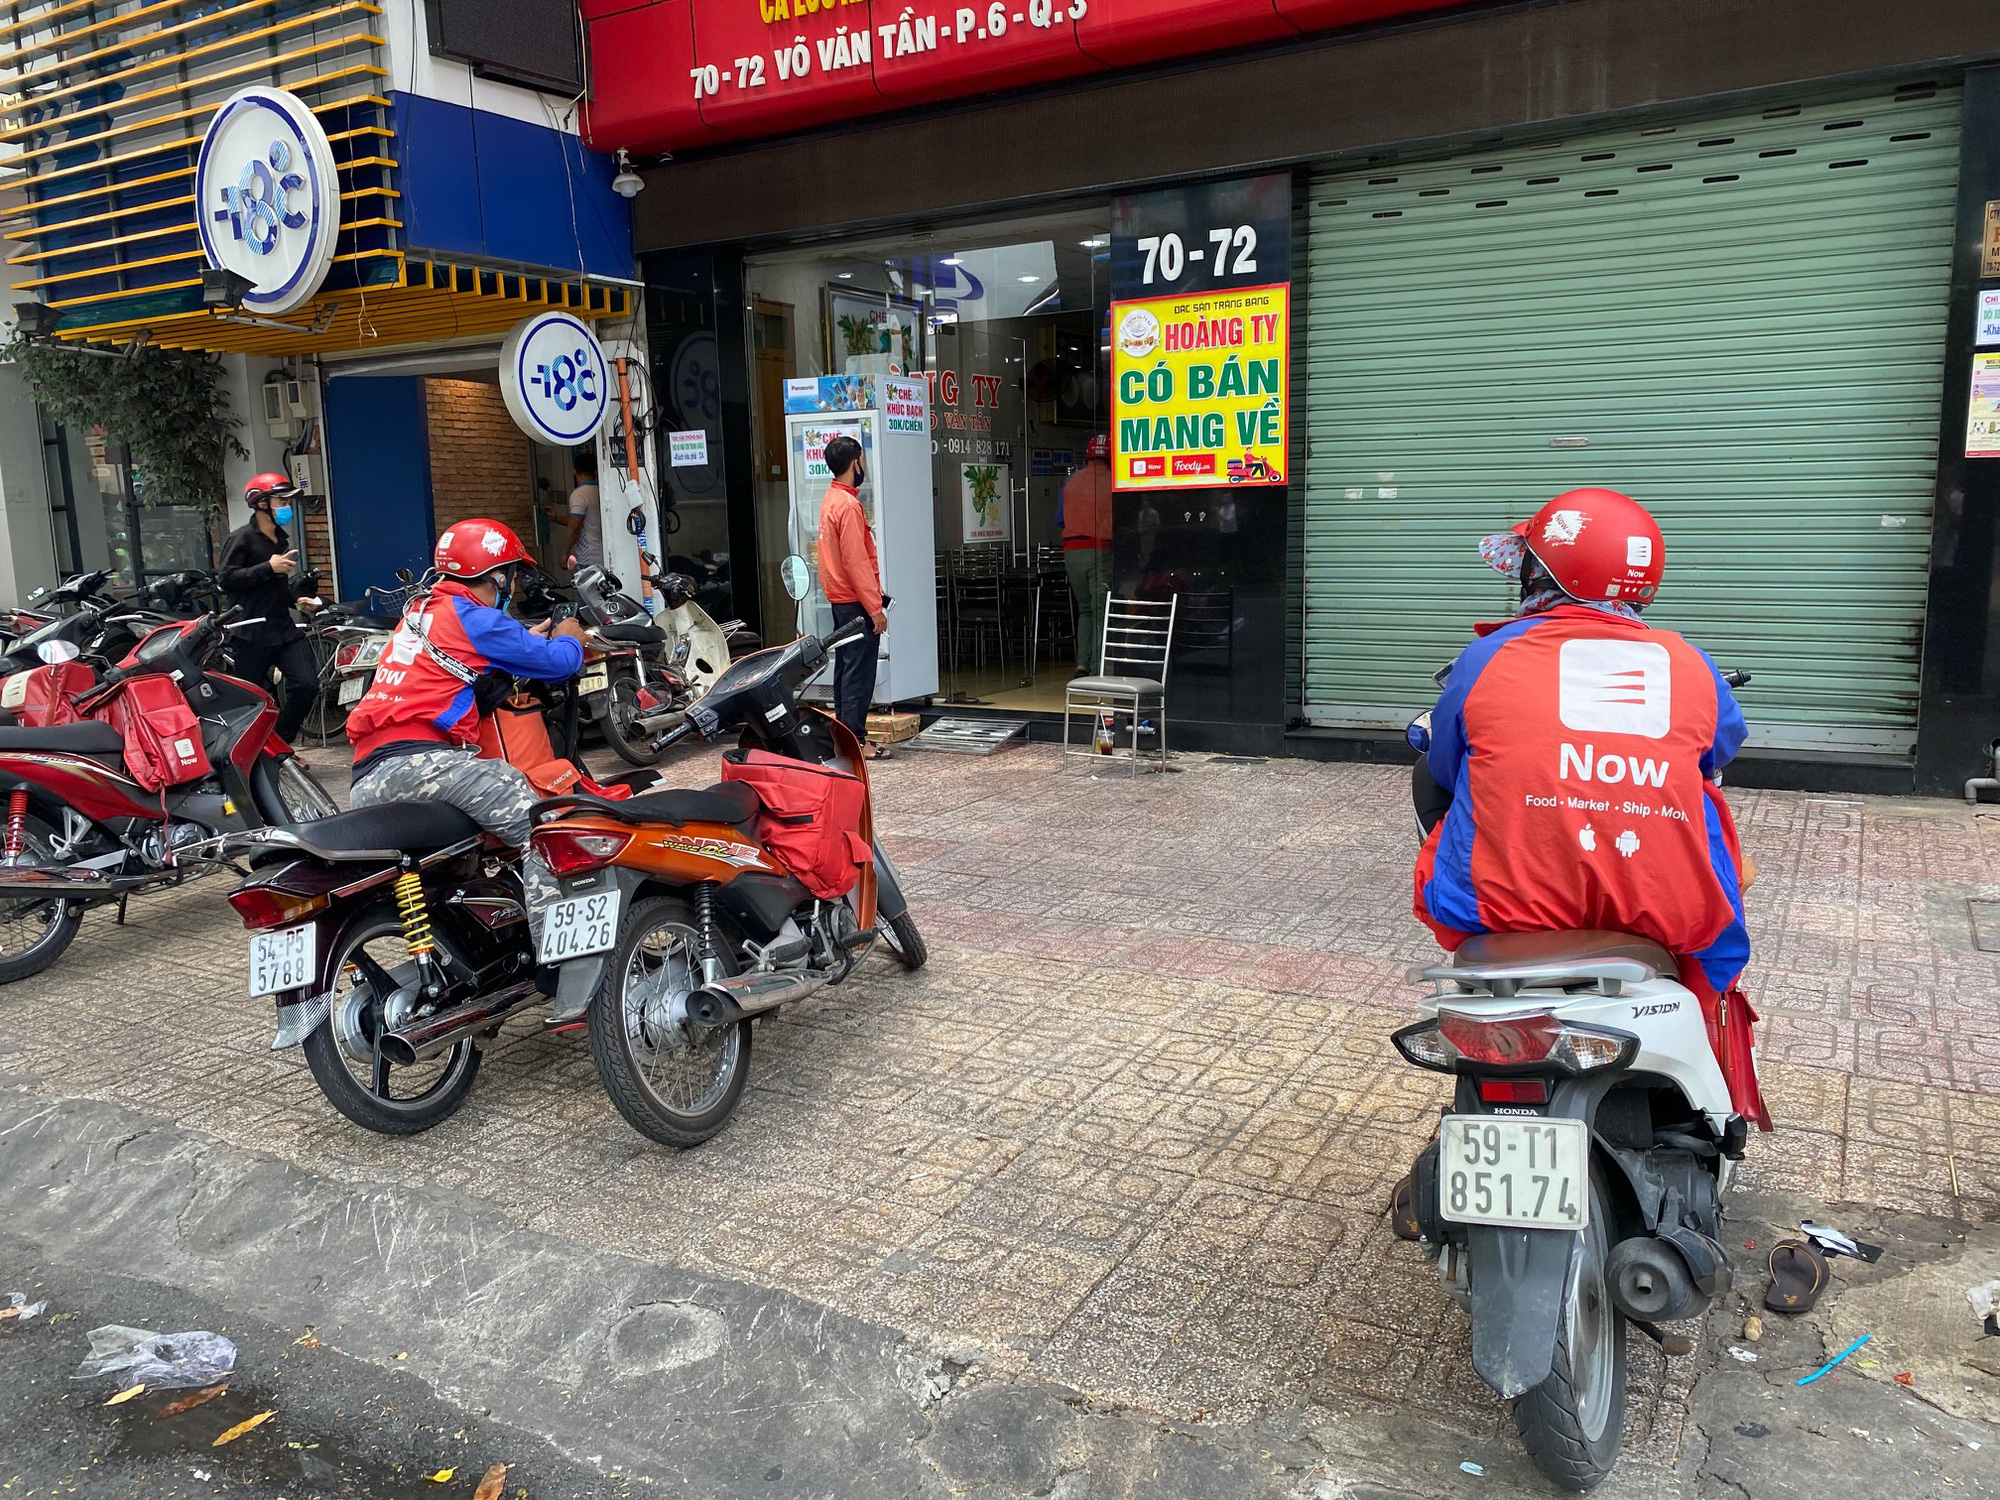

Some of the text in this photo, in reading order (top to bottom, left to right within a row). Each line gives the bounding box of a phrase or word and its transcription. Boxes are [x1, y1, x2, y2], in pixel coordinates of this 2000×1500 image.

[774, 35, 811, 81] VÕ
[816, 26, 872, 71] VĂN
[879, 6, 936, 59] TẦN
[1137, 224, 1258, 285] 70-72
[1165, 313, 1278, 352] HOÀNG TY
[970, 374, 1002, 409] TY
[1119, 353, 1279, 405] CÓ BÁN
[944, 409, 967, 430] VĂN
[1120, 413, 1224, 453] MANG
[1235, 397, 1281, 447] VỀ
[806, 445, 826, 460] KHÚ
[976, 439, 992, 454] 828
[996, 441, 1010, 456] 171
[1627, 568, 1646, 578] Now
[180, 757, 197, 767] Now
[1559, 742, 1670, 788] Now
[1525, 795, 1557, 807] Food
[1567, 796, 1610, 812] Market
[1622, 801, 1650, 817] Ship
[571, 877, 596, 887] HONDA
[554, 895, 608, 928] 59-S2
[258, 927, 304, 963] 54-P5
[543, 921, 611, 958] 404.26
[258, 956, 304, 992] 5788
[1631, 1001, 1680, 1019] VISION
[1493, 1107, 1539, 1116] HONDA
[1463, 1123, 1557, 1169] 59-T1
[1451, 1170, 1577, 1220] 851.74
